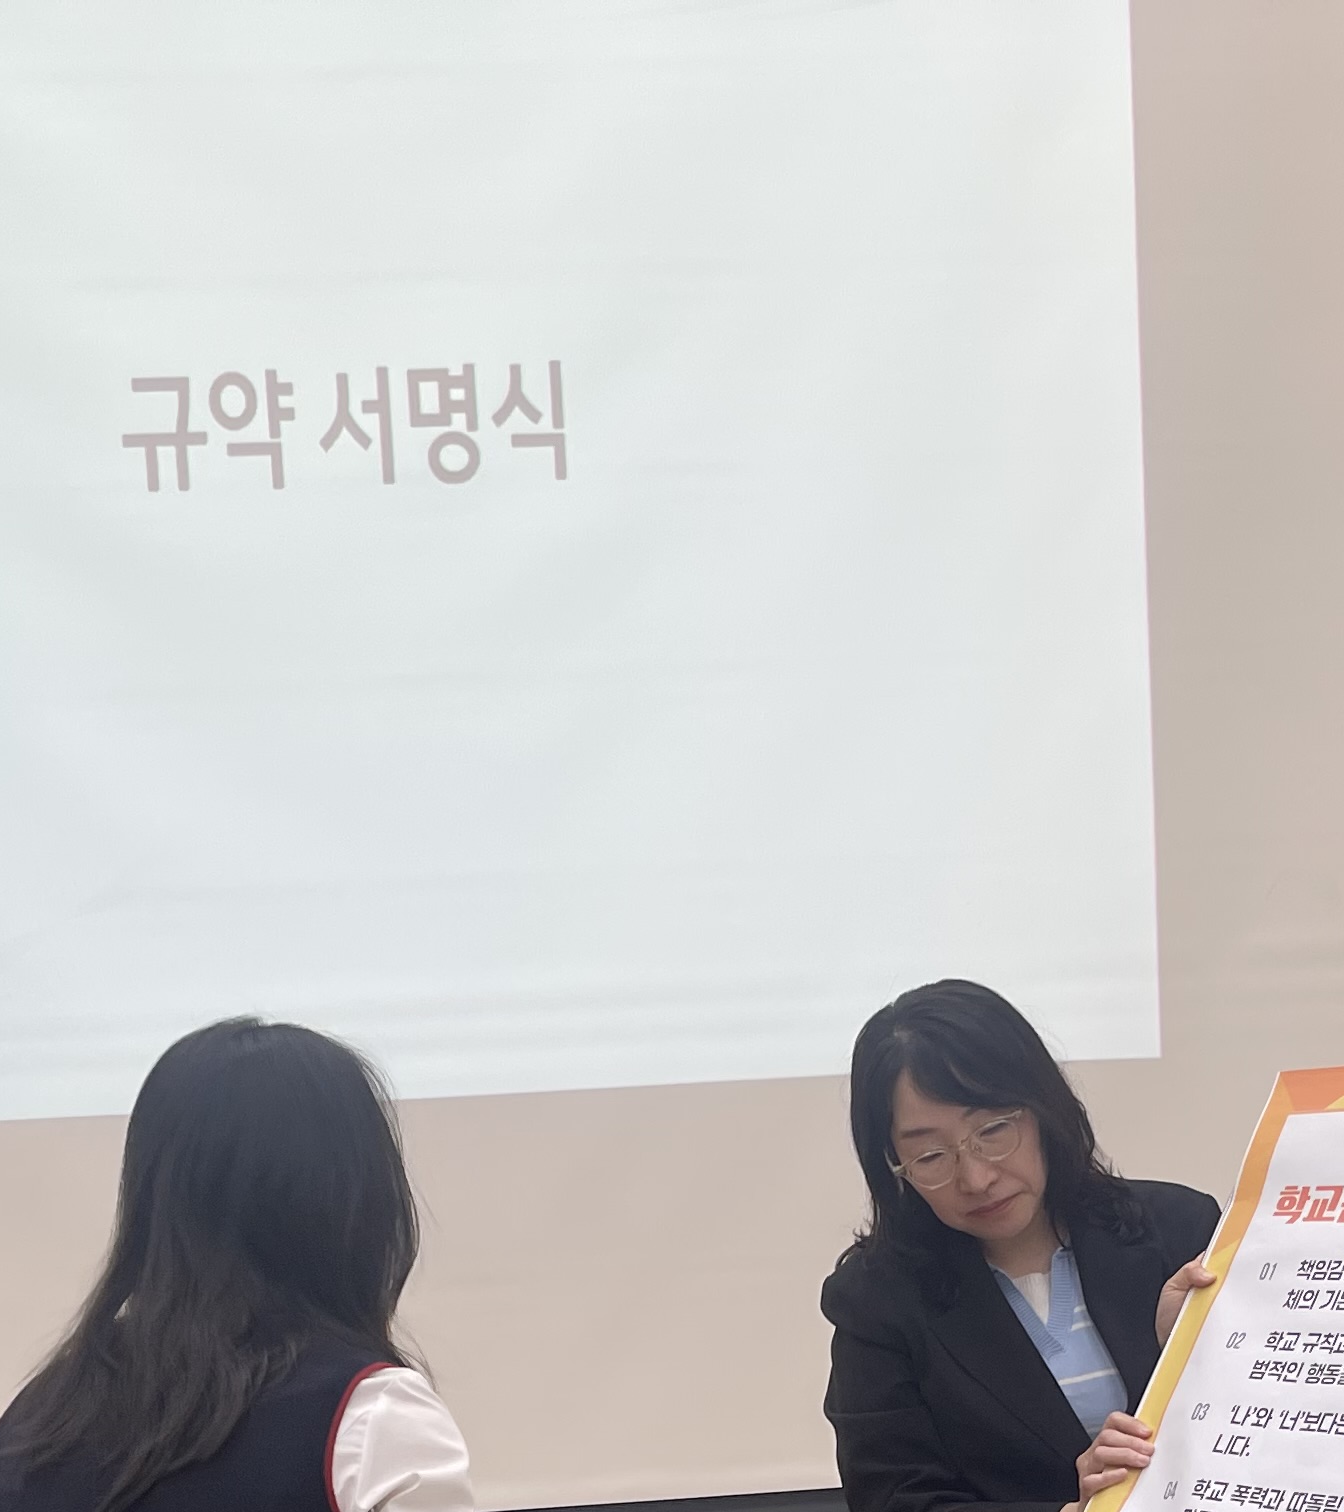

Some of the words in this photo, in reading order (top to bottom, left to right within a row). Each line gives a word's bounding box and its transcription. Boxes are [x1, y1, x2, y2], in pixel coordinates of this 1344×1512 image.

[121, 368, 296, 493] 규약
[318, 359, 568, 486] 서명식
[1259, 1263, 1277, 1281] 01
[1282, 1289, 1316, 1311] 체의
[1226, 1332, 1246, 1350] 02
[1264, 1331, 1300, 1353] 학교
[1248, 1359, 1305, 1383] 범적인
[1191, 1403, 1210, 1421] 03
[1212, 1434, 1251, 1458] 니다.
[1191, 1479, 1228, 1502] 학교
[1230, 1485, 1285, 1511] 폭력과
